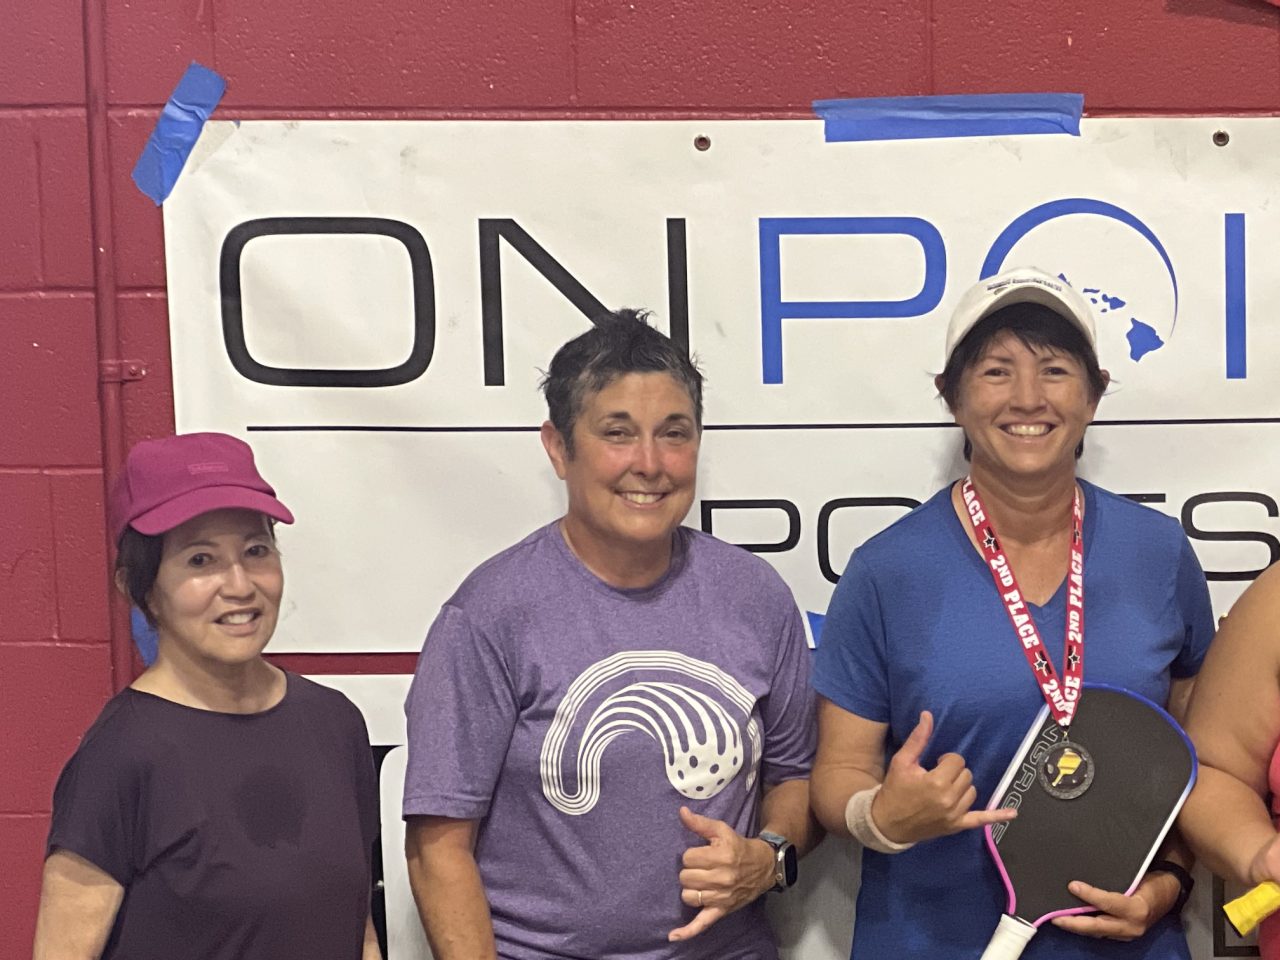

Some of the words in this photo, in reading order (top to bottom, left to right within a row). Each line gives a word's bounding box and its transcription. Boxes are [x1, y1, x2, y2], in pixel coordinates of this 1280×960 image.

[990, 555, 1014, 587] 2ND
[1004, 589, 1040, 649] PLACE
[1070, 550, 1083, 609] PLACE
[1069, 610, 1083, 643] 2ND
[991, 724, 1059, 845] NGAGE
